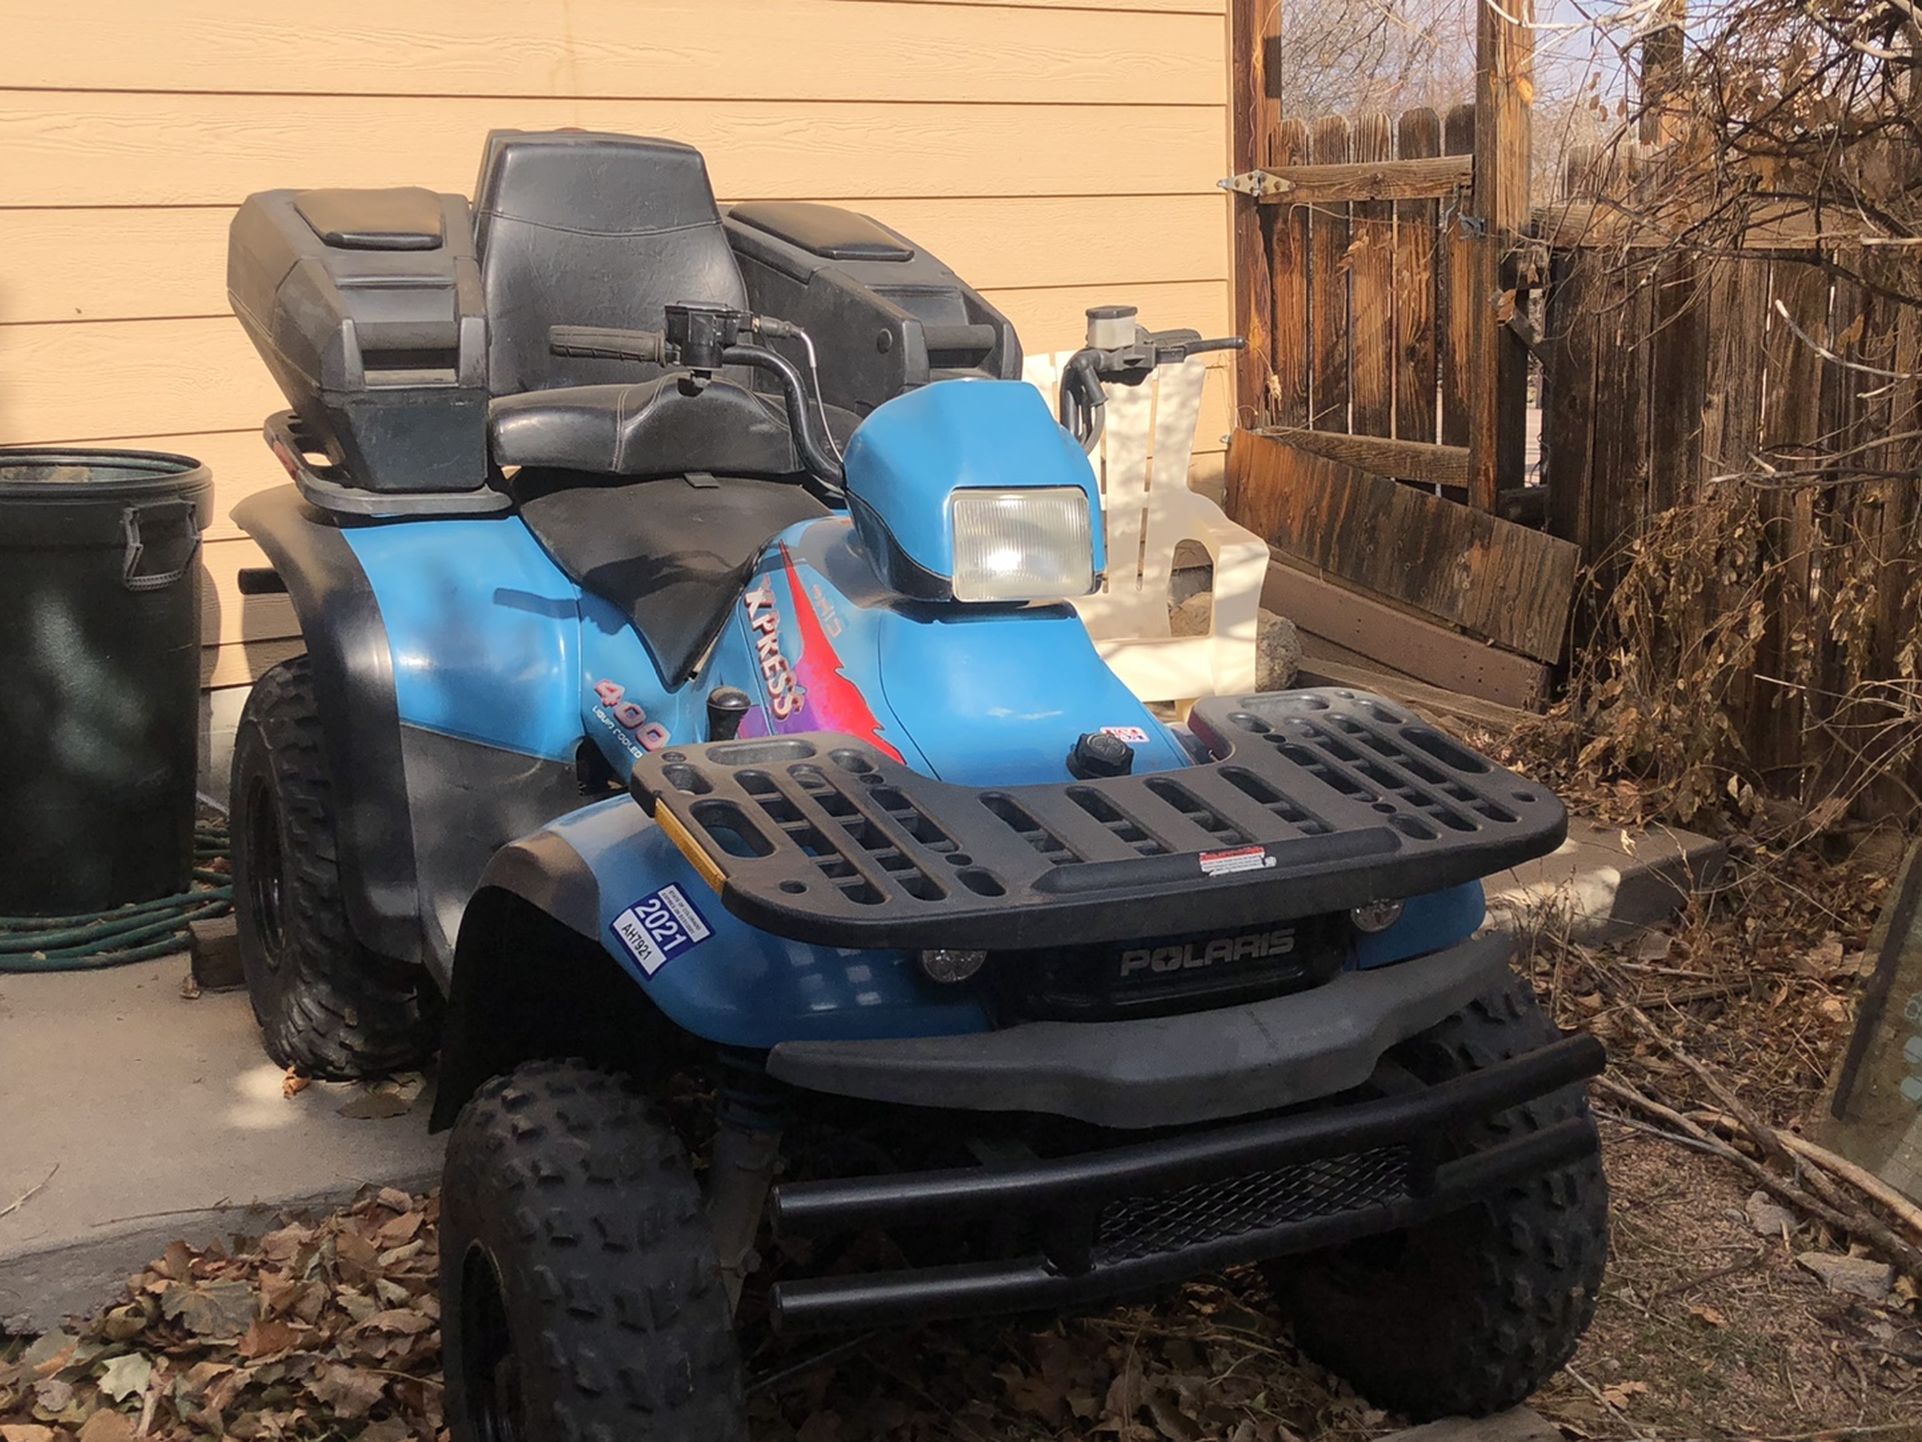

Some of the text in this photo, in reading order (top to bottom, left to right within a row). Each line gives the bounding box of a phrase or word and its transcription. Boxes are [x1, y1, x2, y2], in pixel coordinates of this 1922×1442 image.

[745, 573, 805, 721] XPRESS
[594, 679, 671, 752] 400
[612, 728, 643, 759] COOLED
[622, 923, 652, 960] AH7921
[635, 899, 687, 951] 2021
[1120, 928, 1295, 976] POLARIS
